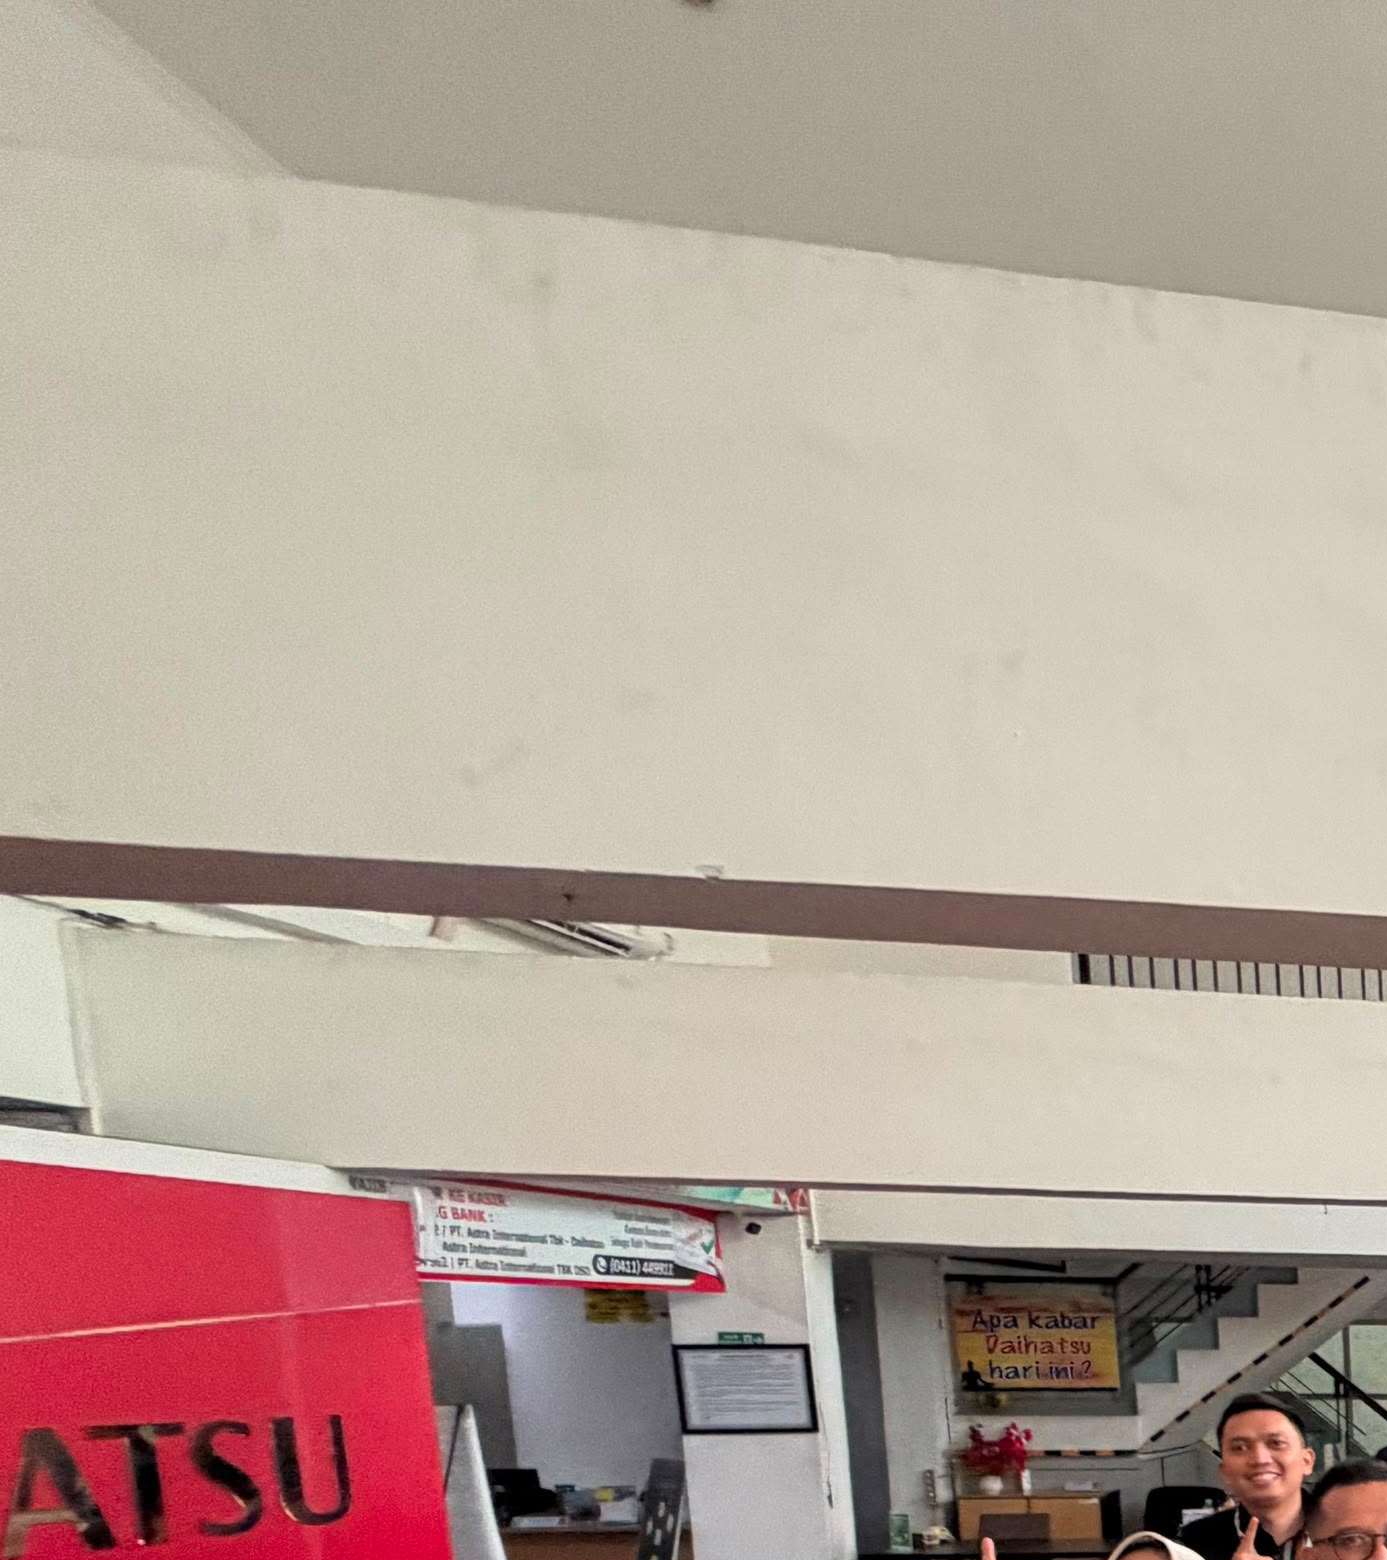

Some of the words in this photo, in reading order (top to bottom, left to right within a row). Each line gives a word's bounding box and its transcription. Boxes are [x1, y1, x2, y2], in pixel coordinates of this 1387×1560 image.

[451, 1207, 487, 1223] BANK
[610, 1258, 640, 1275] (0411)
[972, 1309, 1018, 1332] Apa
[1028, 1311, 1101, 1330] kabar
[985, 1335, 1092, 1355] Daihatsu
[988, 1360, 1041, 1380] hari
[1049, 1361, 1075, 1380] ini
